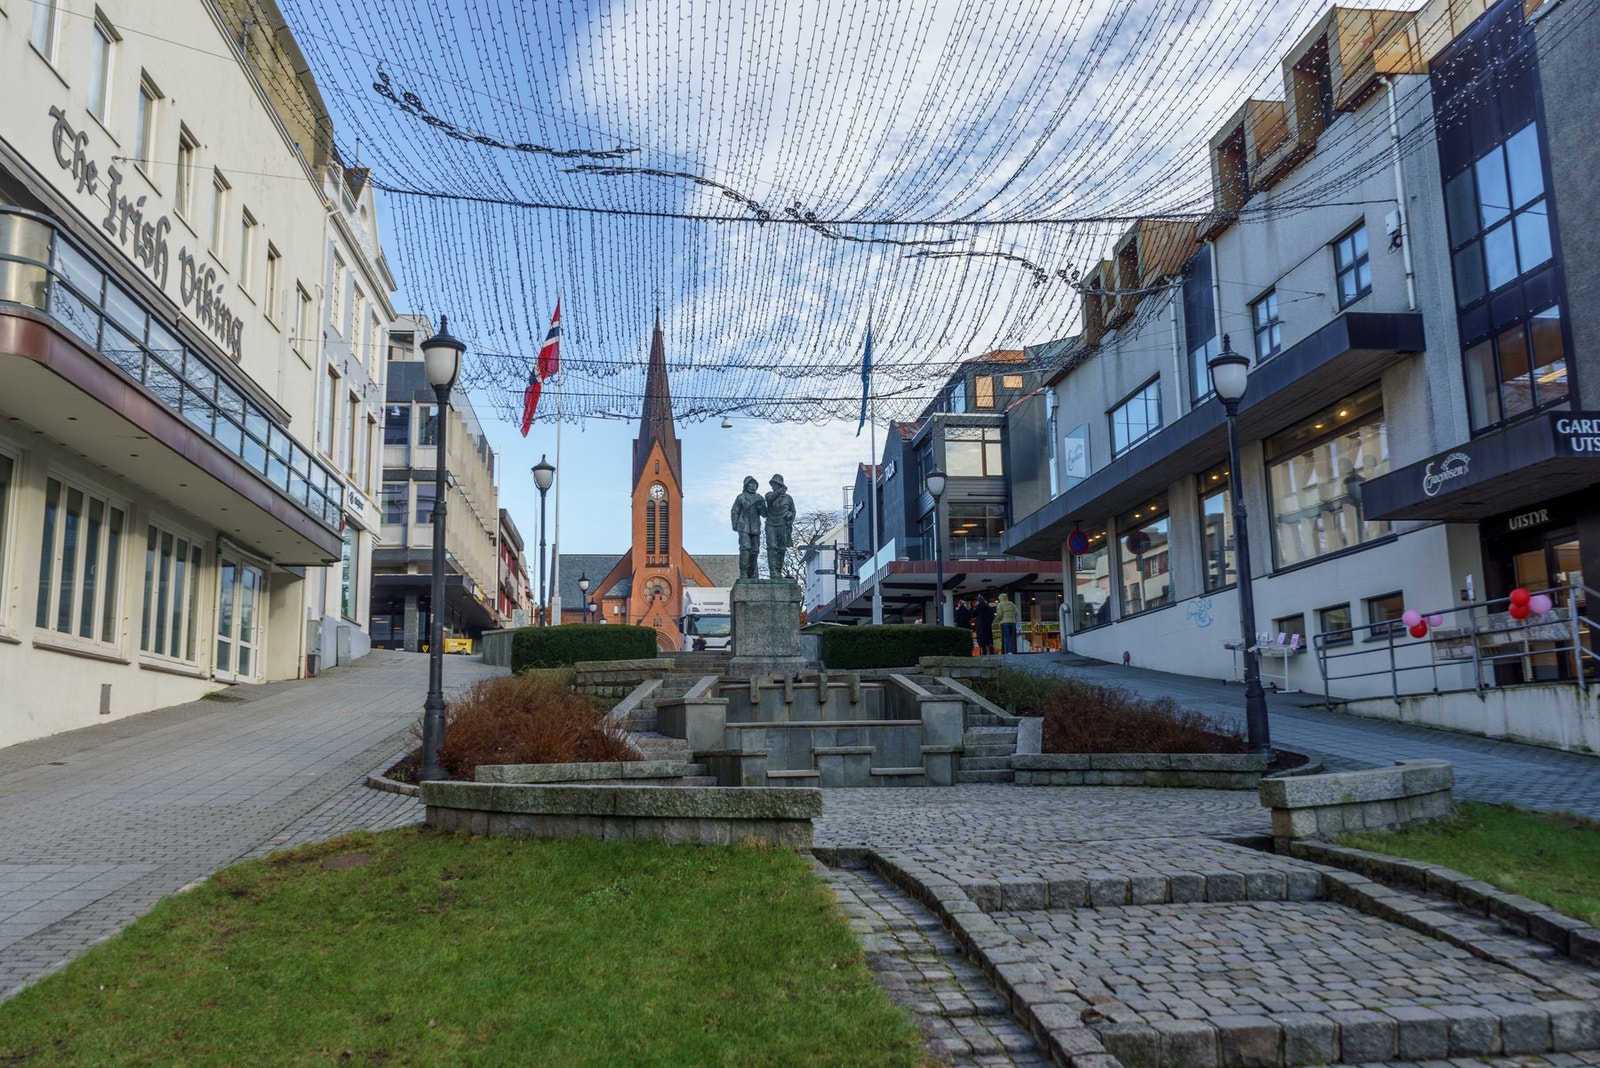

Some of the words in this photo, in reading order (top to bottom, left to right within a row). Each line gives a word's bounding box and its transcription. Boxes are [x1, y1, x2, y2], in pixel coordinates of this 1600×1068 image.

[49, 105, 99, 195] The
[103, 165, 171, 291] Irish
[179, 246, 243, 363] Viking
[1571, 437, 1600, 451] UTS
[1509, 509, 1548, 529] UTSTYR
